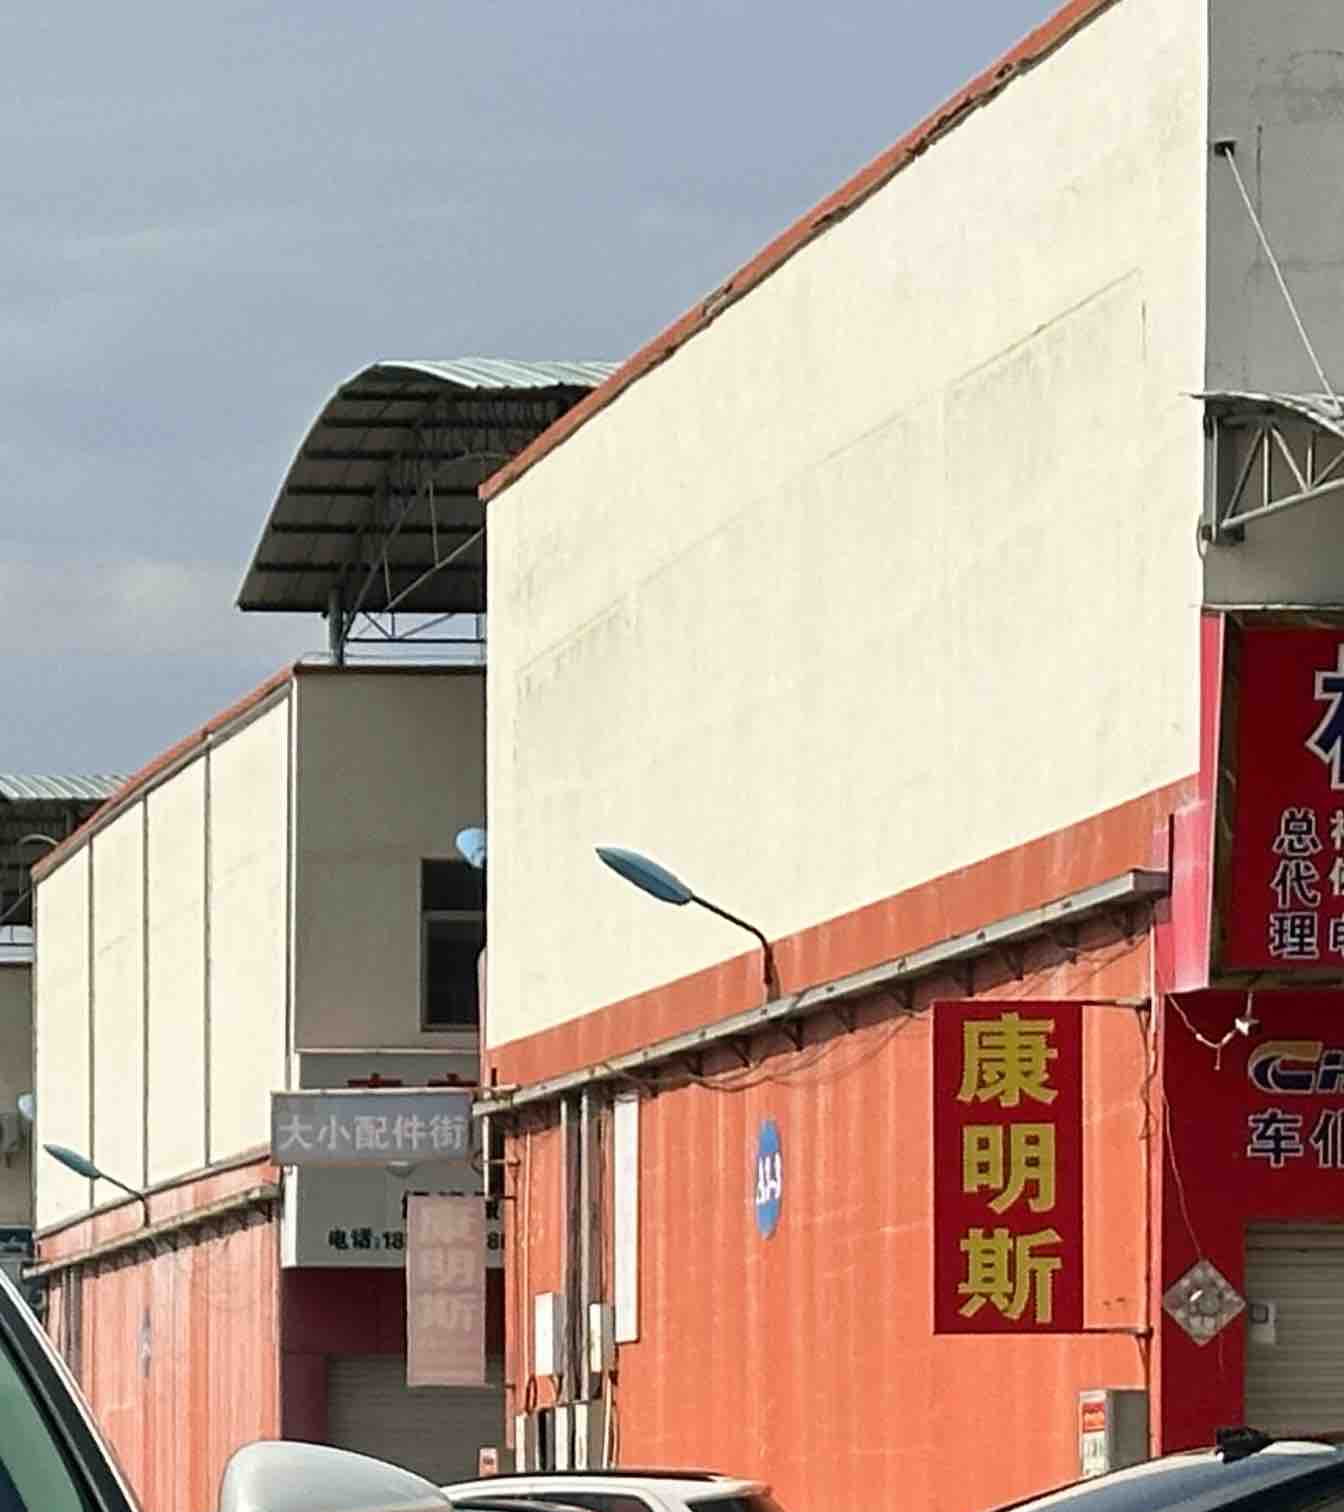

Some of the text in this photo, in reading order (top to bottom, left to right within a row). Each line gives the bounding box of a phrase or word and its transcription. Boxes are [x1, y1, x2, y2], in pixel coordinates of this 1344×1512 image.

[1269, 807, 1323, 959] 总代理
[278, 1113, 466, 1151] 大小配件街
[956, 1012, 1064, 1325] 康明斯
